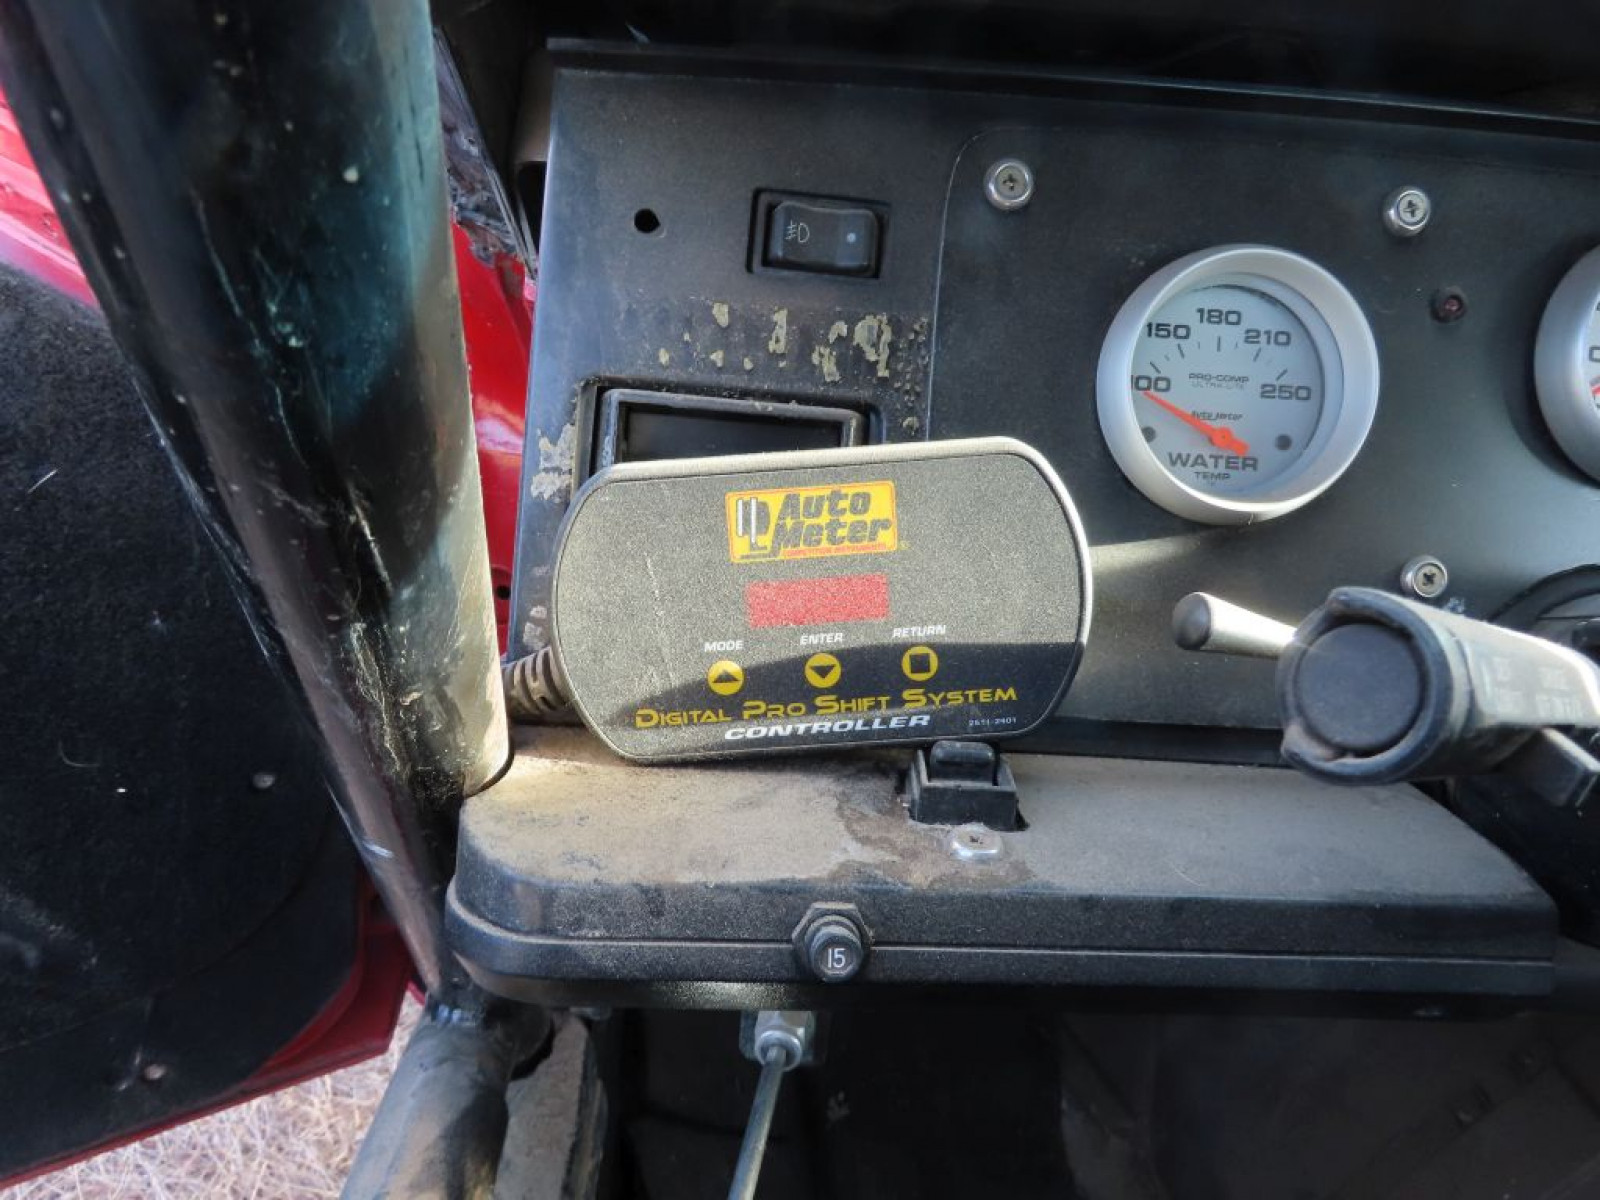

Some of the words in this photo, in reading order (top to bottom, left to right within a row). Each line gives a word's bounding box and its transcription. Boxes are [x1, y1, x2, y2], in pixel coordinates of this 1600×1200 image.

[1196, 307, 1242, 326] 180
[1146, 322, 1191, 340] 150
[1243, 328, 1292, 347] 210
[1260, 383, 1312, 401] 250
[1167, 452, 1259, 471] WATER
[1194, 471, 1231, 481] TEMP
[777, 489, 872, 519] Auto
[772, 517, 893, 550] Meter
[800, 632, 844, 645] ENTER
[891, 624, 947, 638] RETURN
[704, 639, 744, 653] MODE
[635, 707, 731, 728] DIGITAL
[742, 700, 806, 720] PRO
[815, 694, 891, 715] SHIFT
[903, 687, 1018, 708] SYSTEM
[724, 714, 931, 741] CONTROLLER
[827, 947, 847, 969] 15
